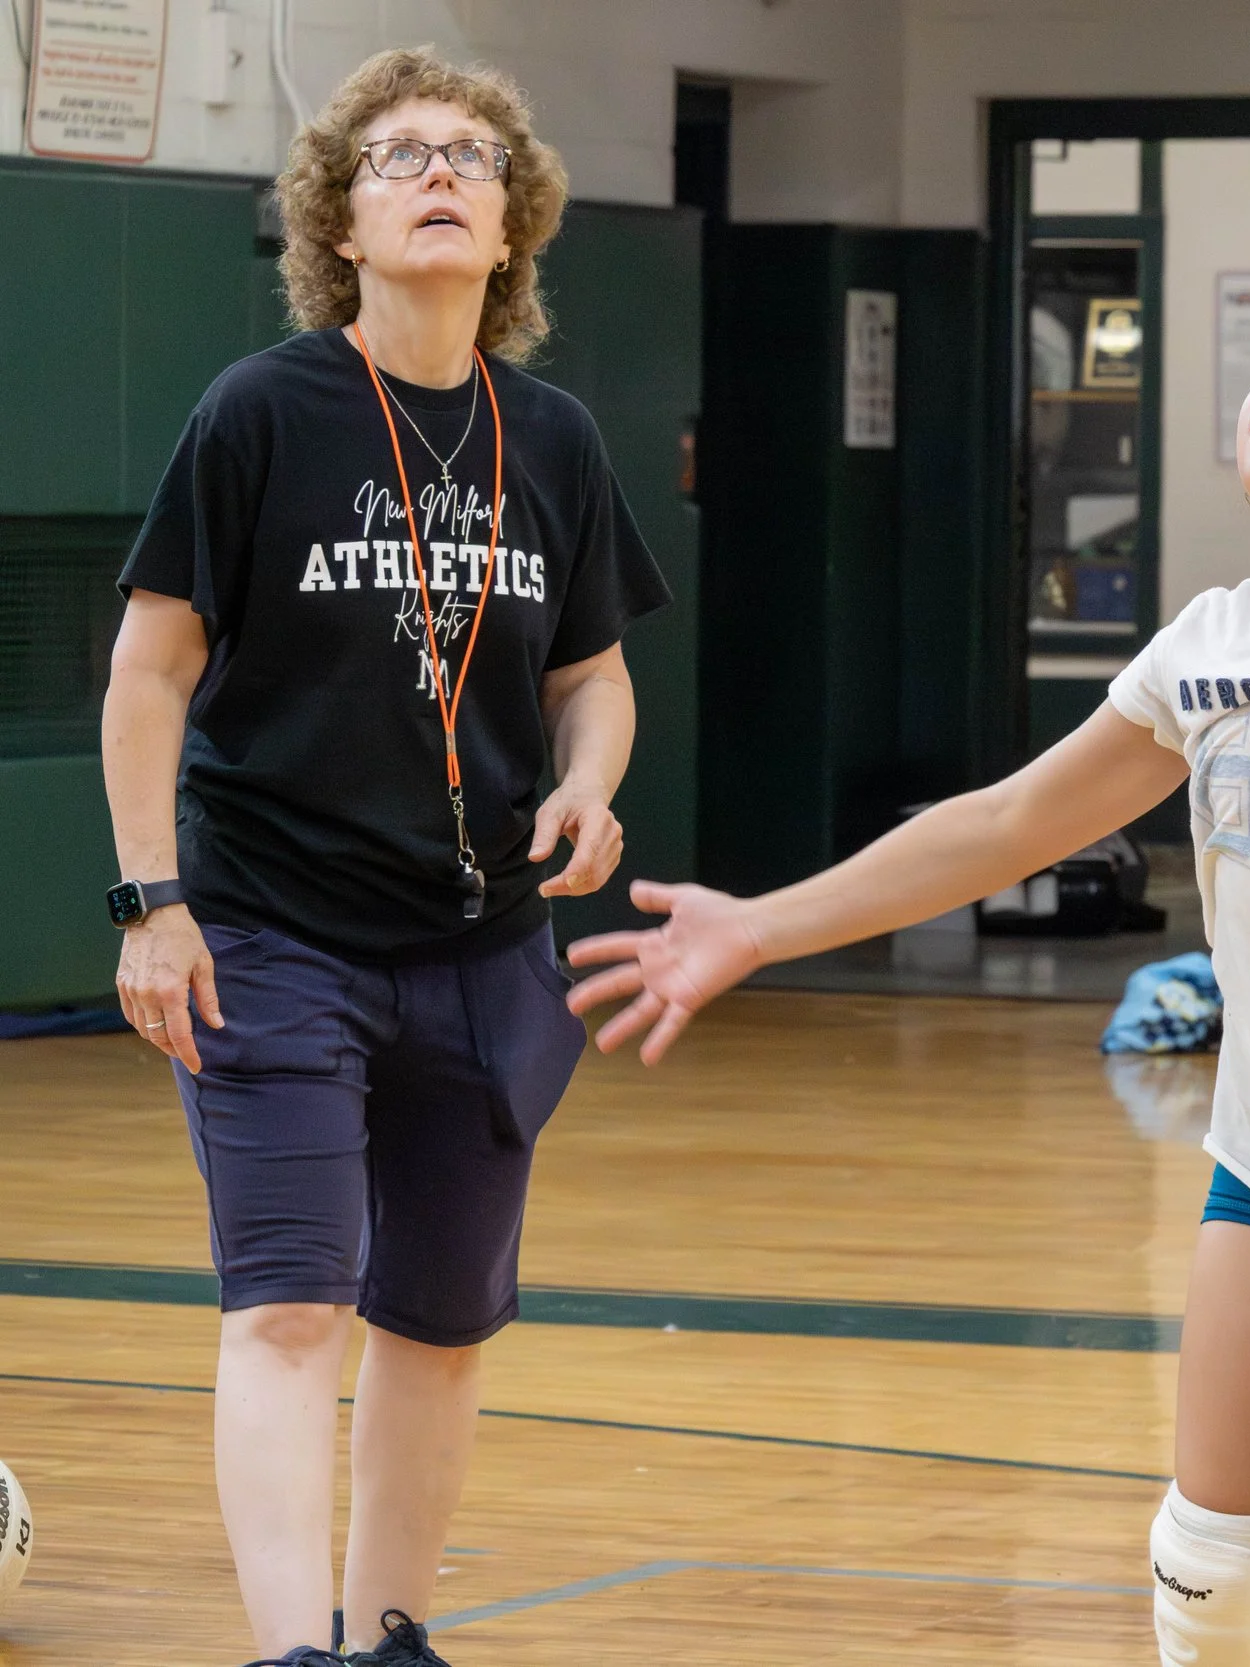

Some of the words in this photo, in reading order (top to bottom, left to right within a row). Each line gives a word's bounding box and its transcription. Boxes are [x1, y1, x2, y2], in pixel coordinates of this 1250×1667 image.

[354, 479, 414, 538] New
[419, 483, 506, 544] Milford
[299, 540, 545, 603] ATHLETICS
